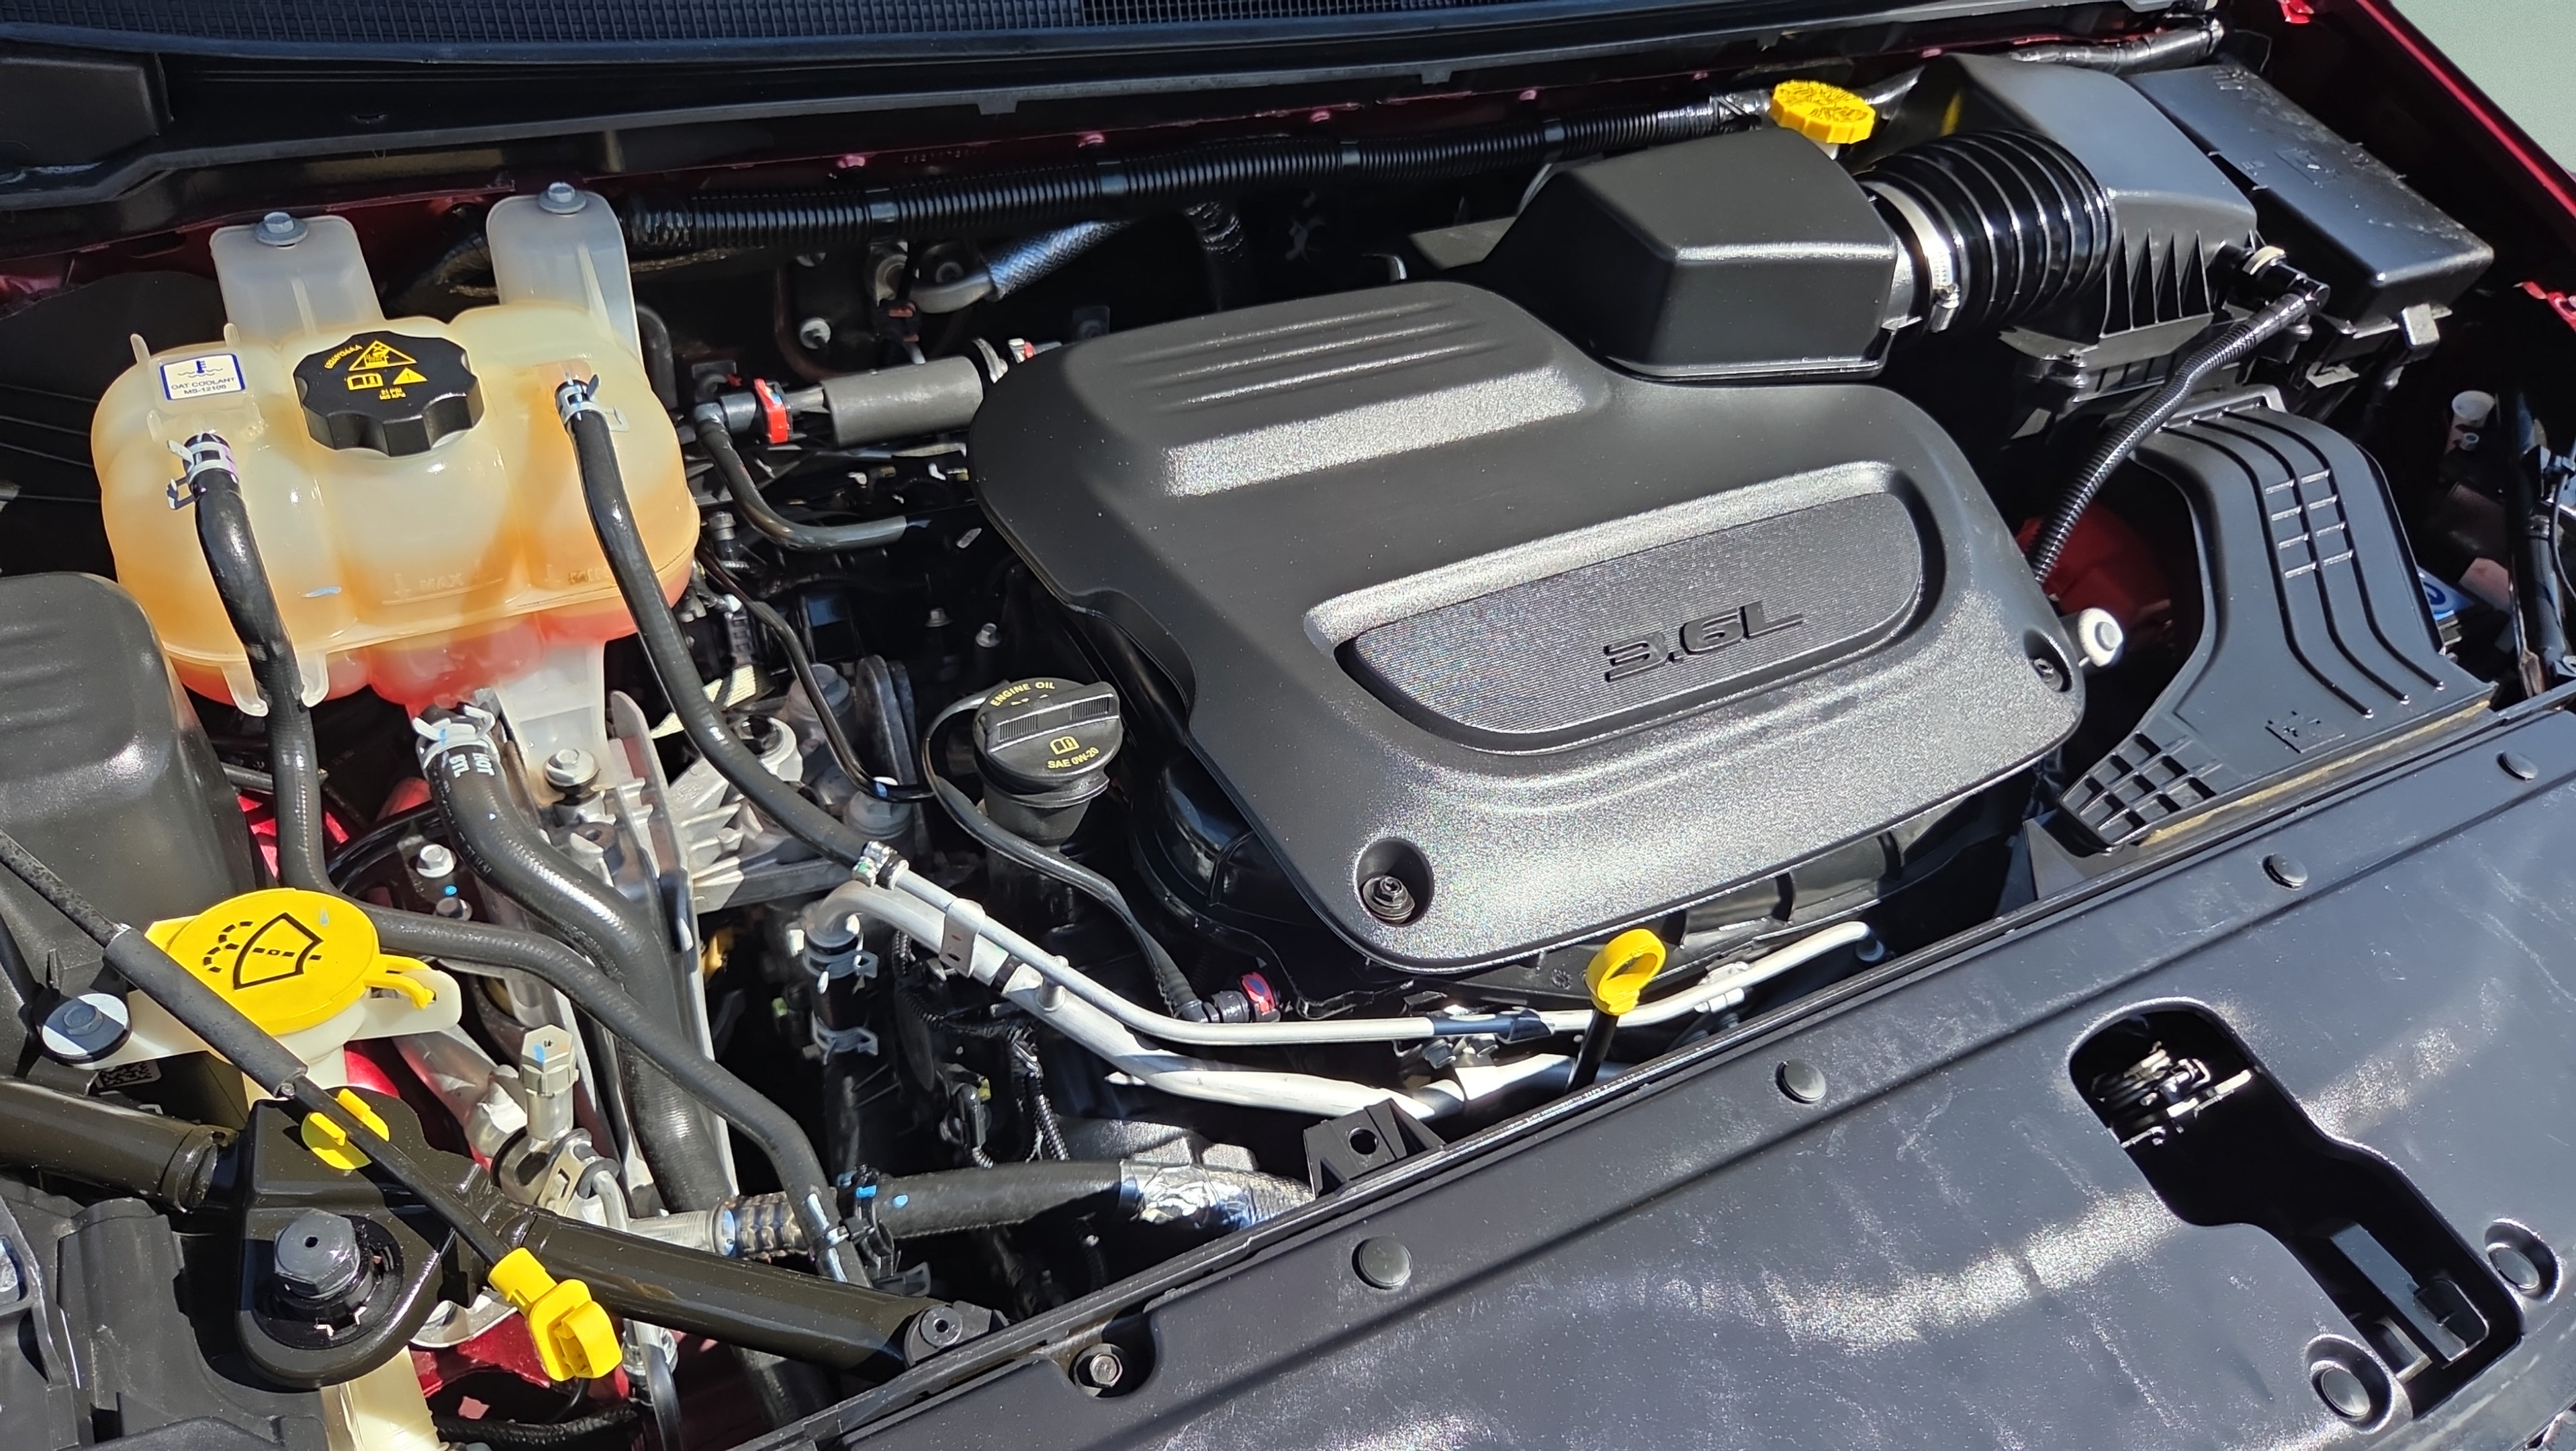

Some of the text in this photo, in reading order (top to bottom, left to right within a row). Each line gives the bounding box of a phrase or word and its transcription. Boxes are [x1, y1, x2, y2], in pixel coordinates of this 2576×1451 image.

[183, 384, 227, 395] MS-12106
[191, 377, 236, 388] COOLANT
[1603, 601, 1806, 683] 3.6L
[989, 681, 1056, 707] ENGINE OIL
[449, 753, 470, 779] BTL
[471, 752, 496, 777] HOT
[1047, 746, 1100, 769] SAE 0W-20
